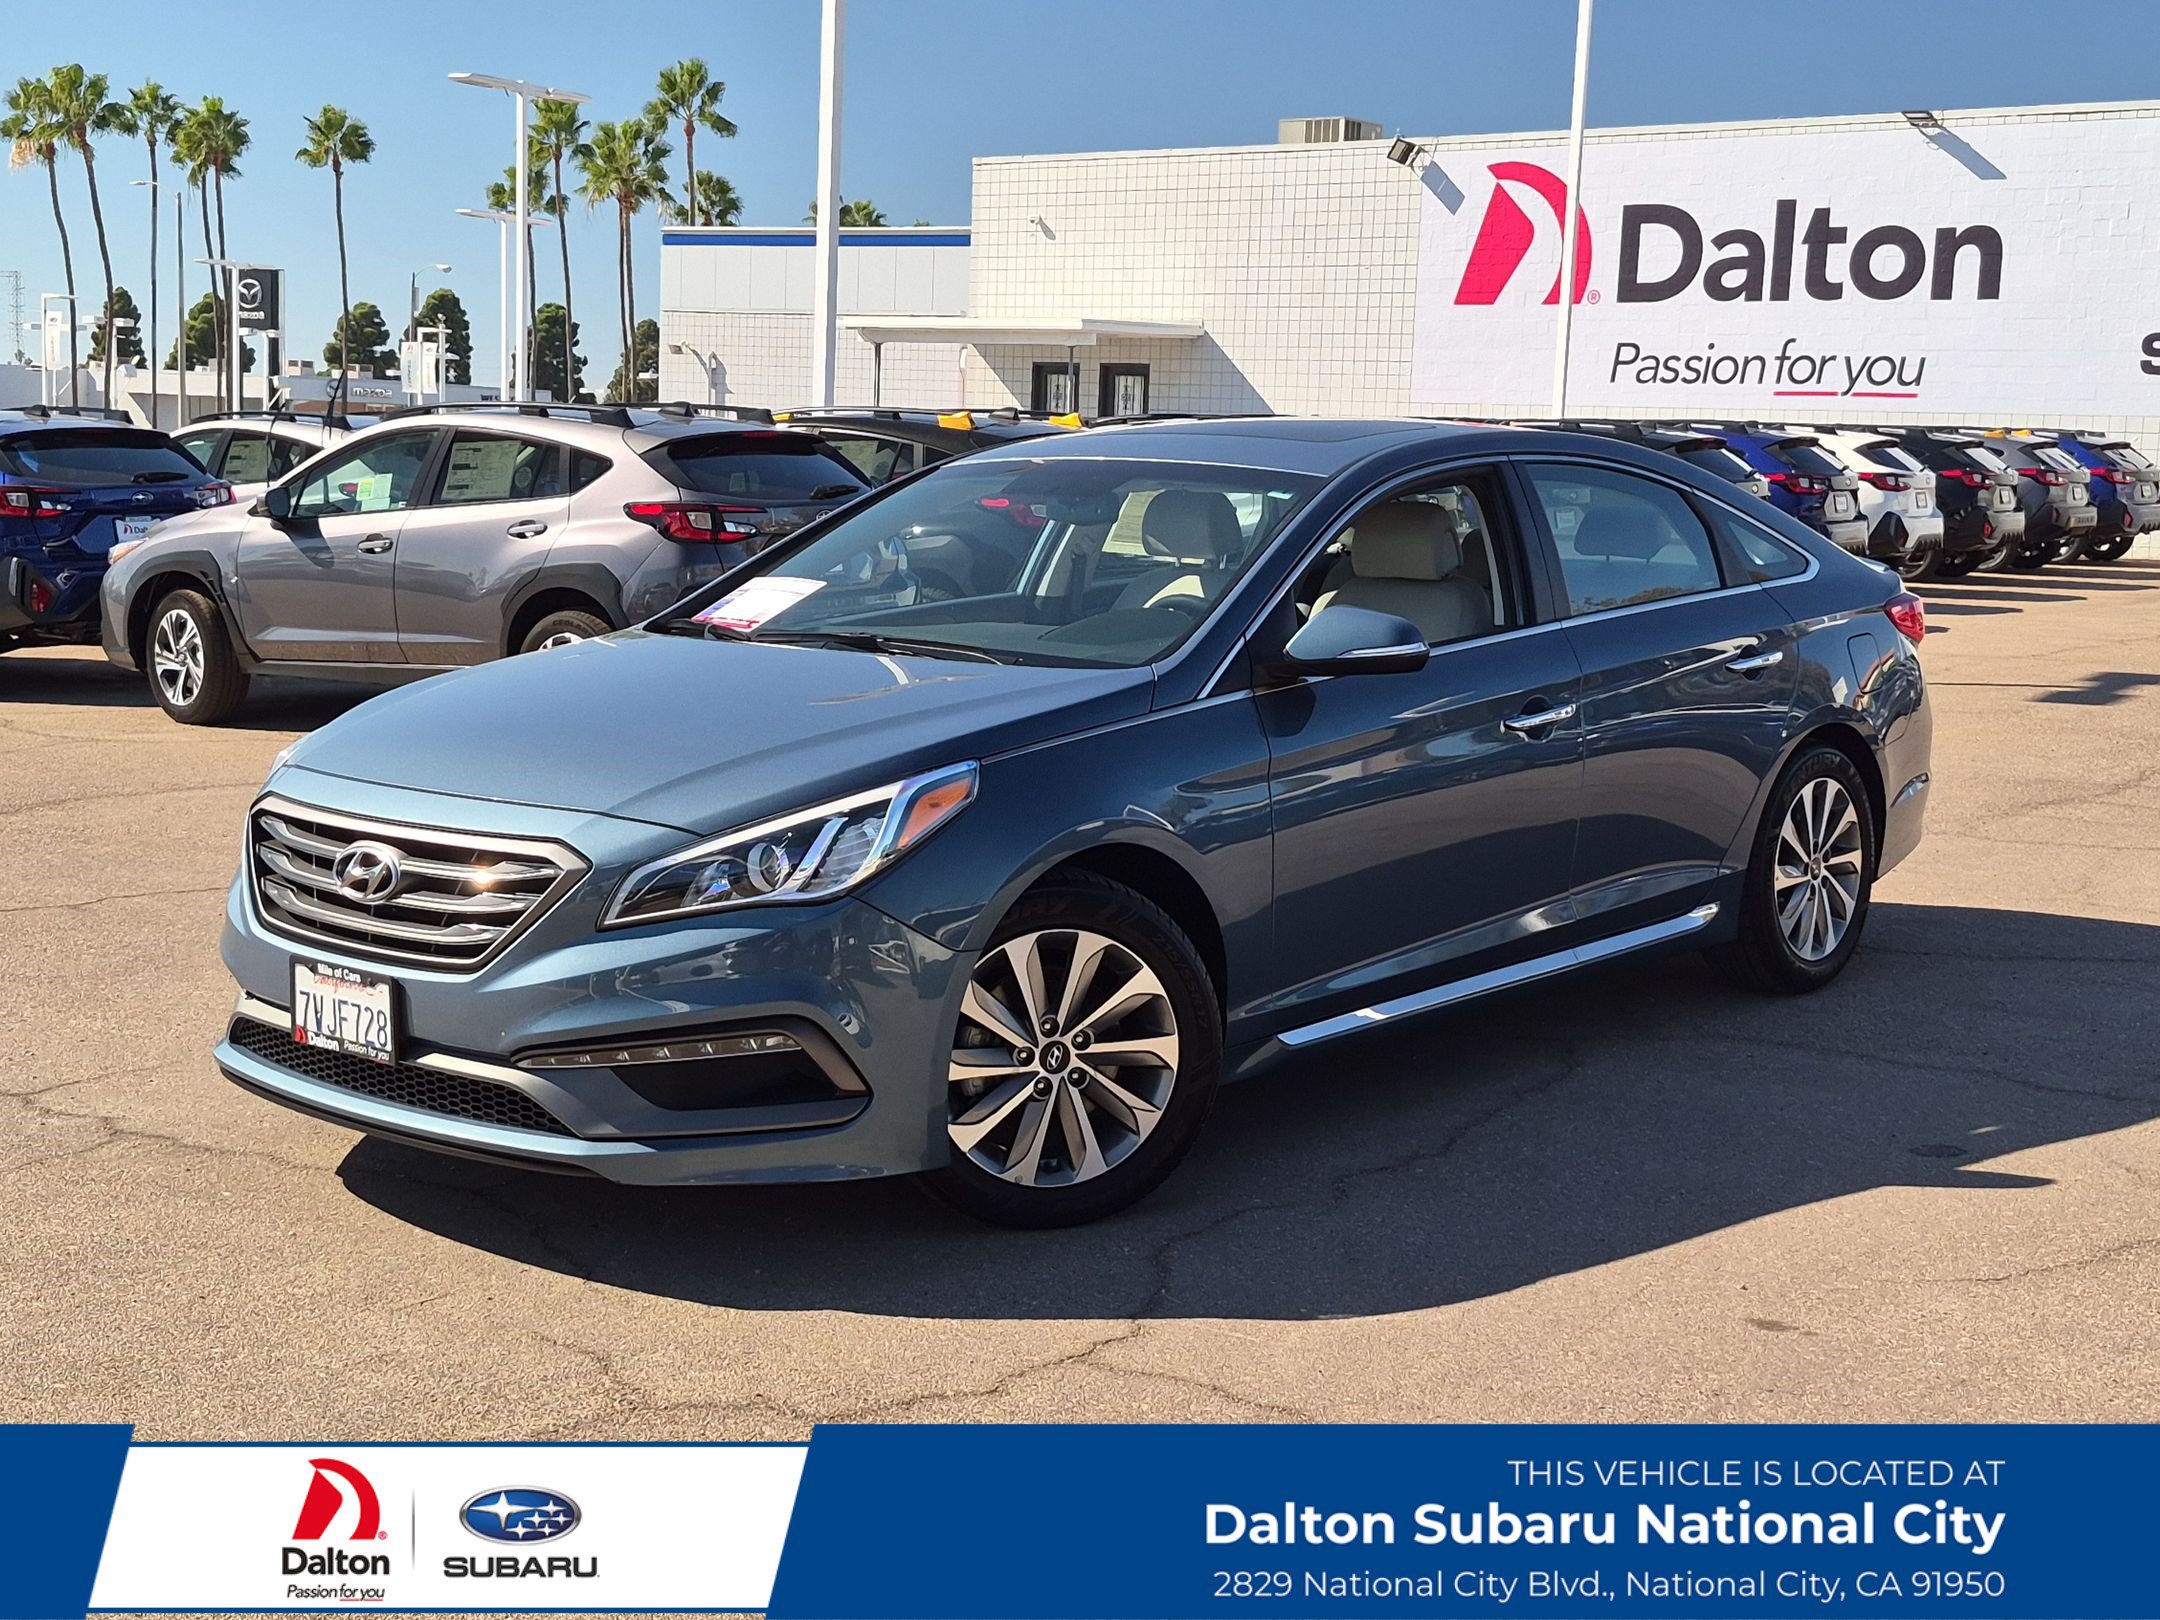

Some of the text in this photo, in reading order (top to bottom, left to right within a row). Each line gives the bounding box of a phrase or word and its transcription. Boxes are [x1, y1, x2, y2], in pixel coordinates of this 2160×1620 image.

[1616, 199, 2003, 303] Dalton
[1610, 338, 1926, 396] Passion for you
[353, 387, 392, 397] mazda
[317, 962, 362, 983] Mile of Cars
[299, 989, 388, 1049] 7VJF728
[307, 1032, 390, 1061] Dalton Passion for you
